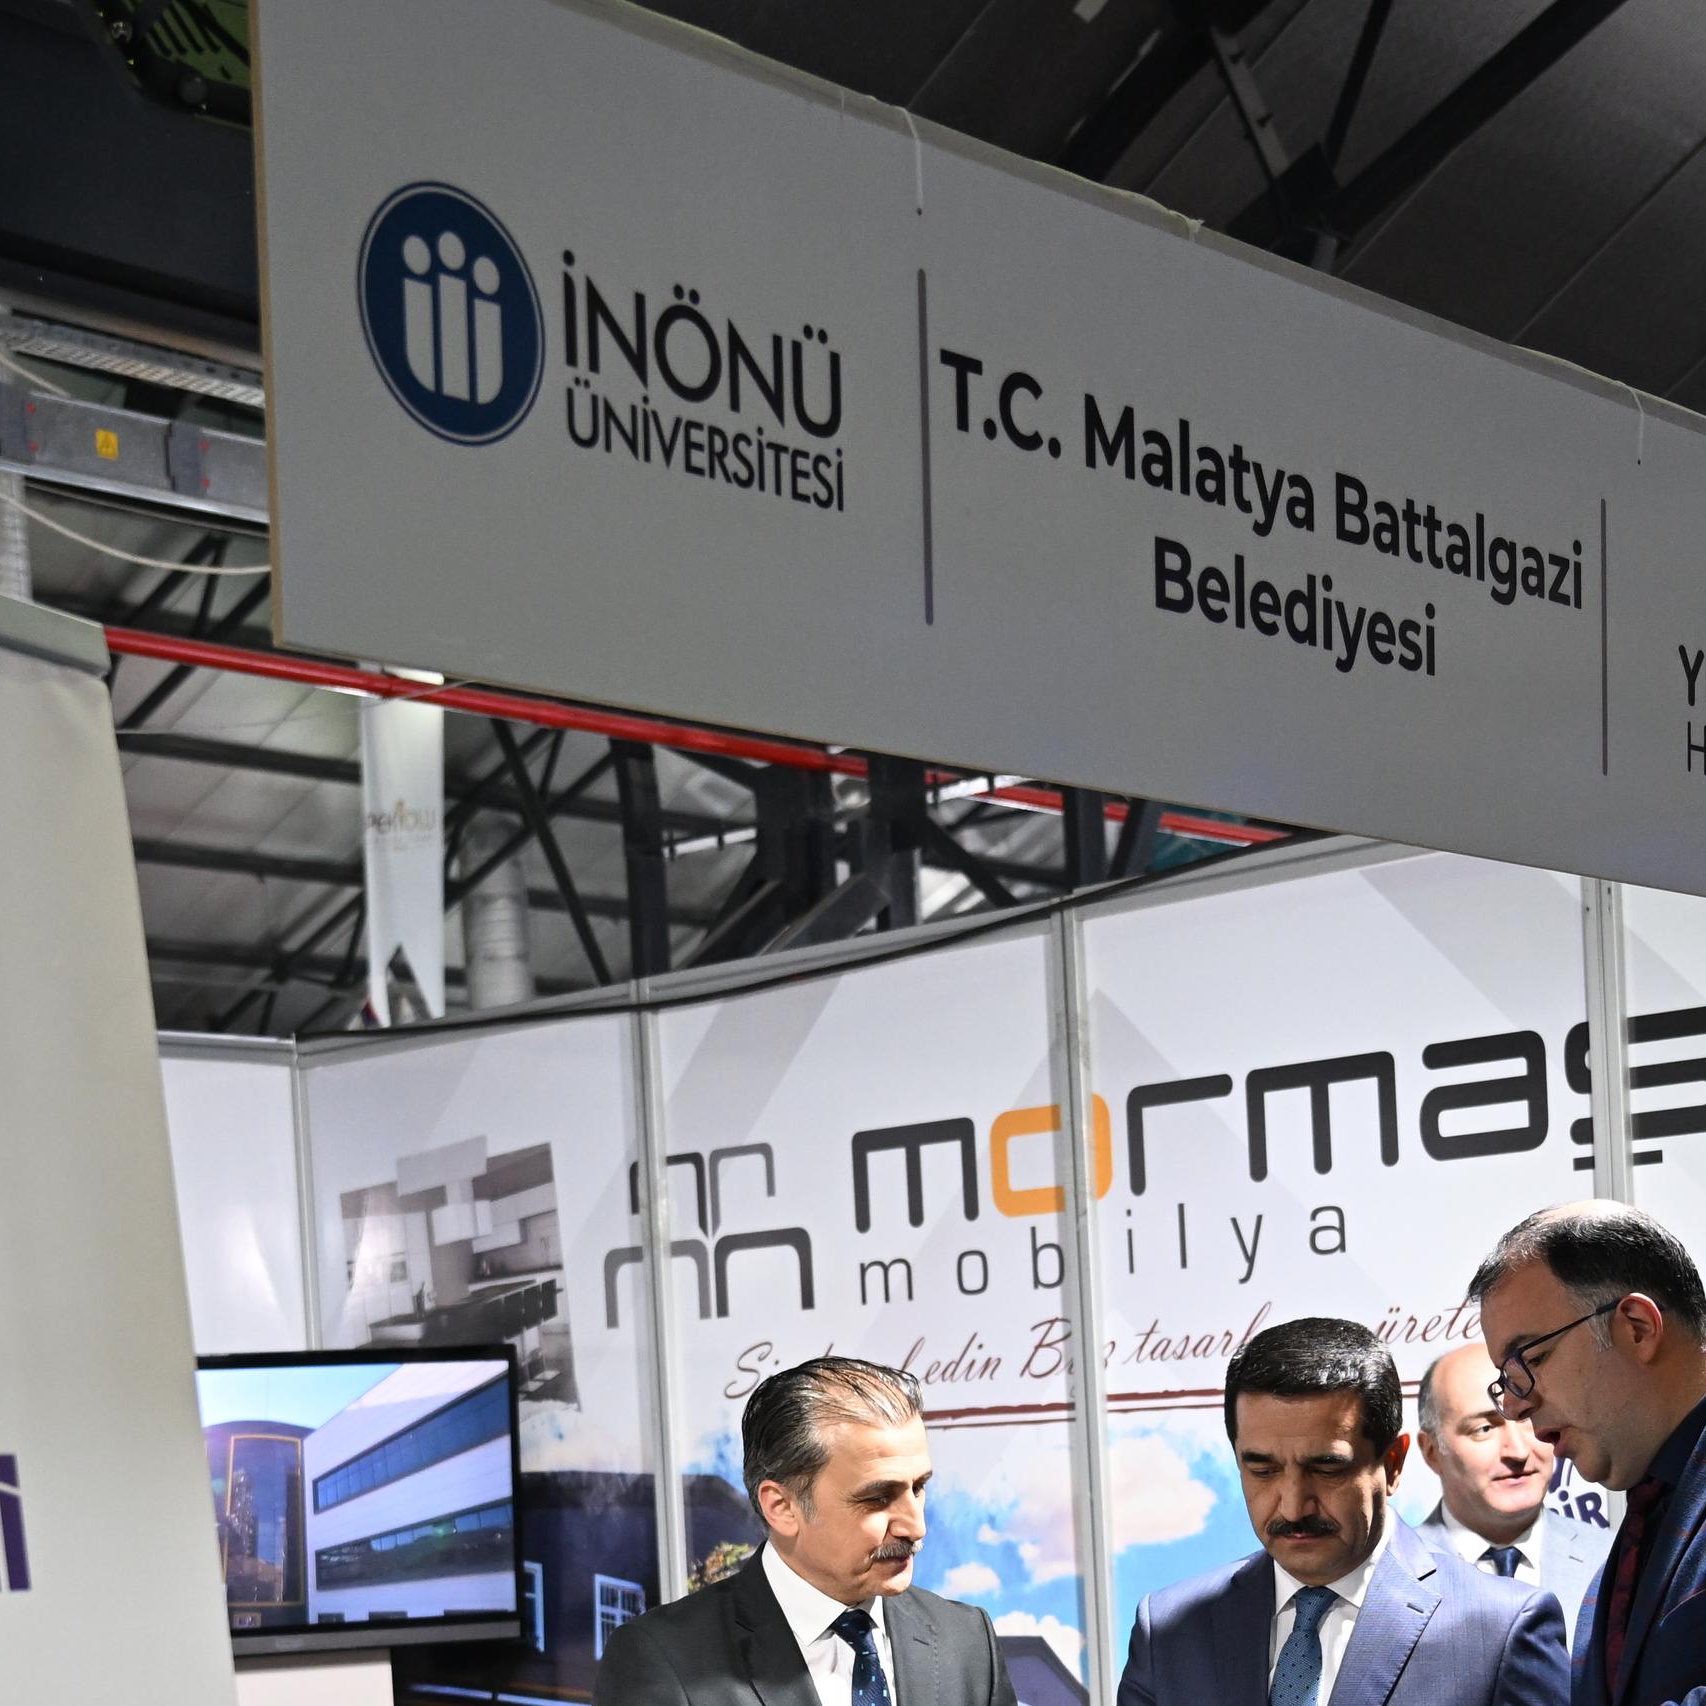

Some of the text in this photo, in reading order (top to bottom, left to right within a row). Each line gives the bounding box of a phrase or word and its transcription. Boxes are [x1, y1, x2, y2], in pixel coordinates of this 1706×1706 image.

[563, 249, 842, 439] İNÖNÜ
[566, 376, 844, 512] ÜNİVERSİTESİ
[939, 348, 1583, 610] T.C. Malatya Battalgazi
[1154, 536, 1436, 676] Belediyesi
[859, 1203, 1347, 1306] mobilya
